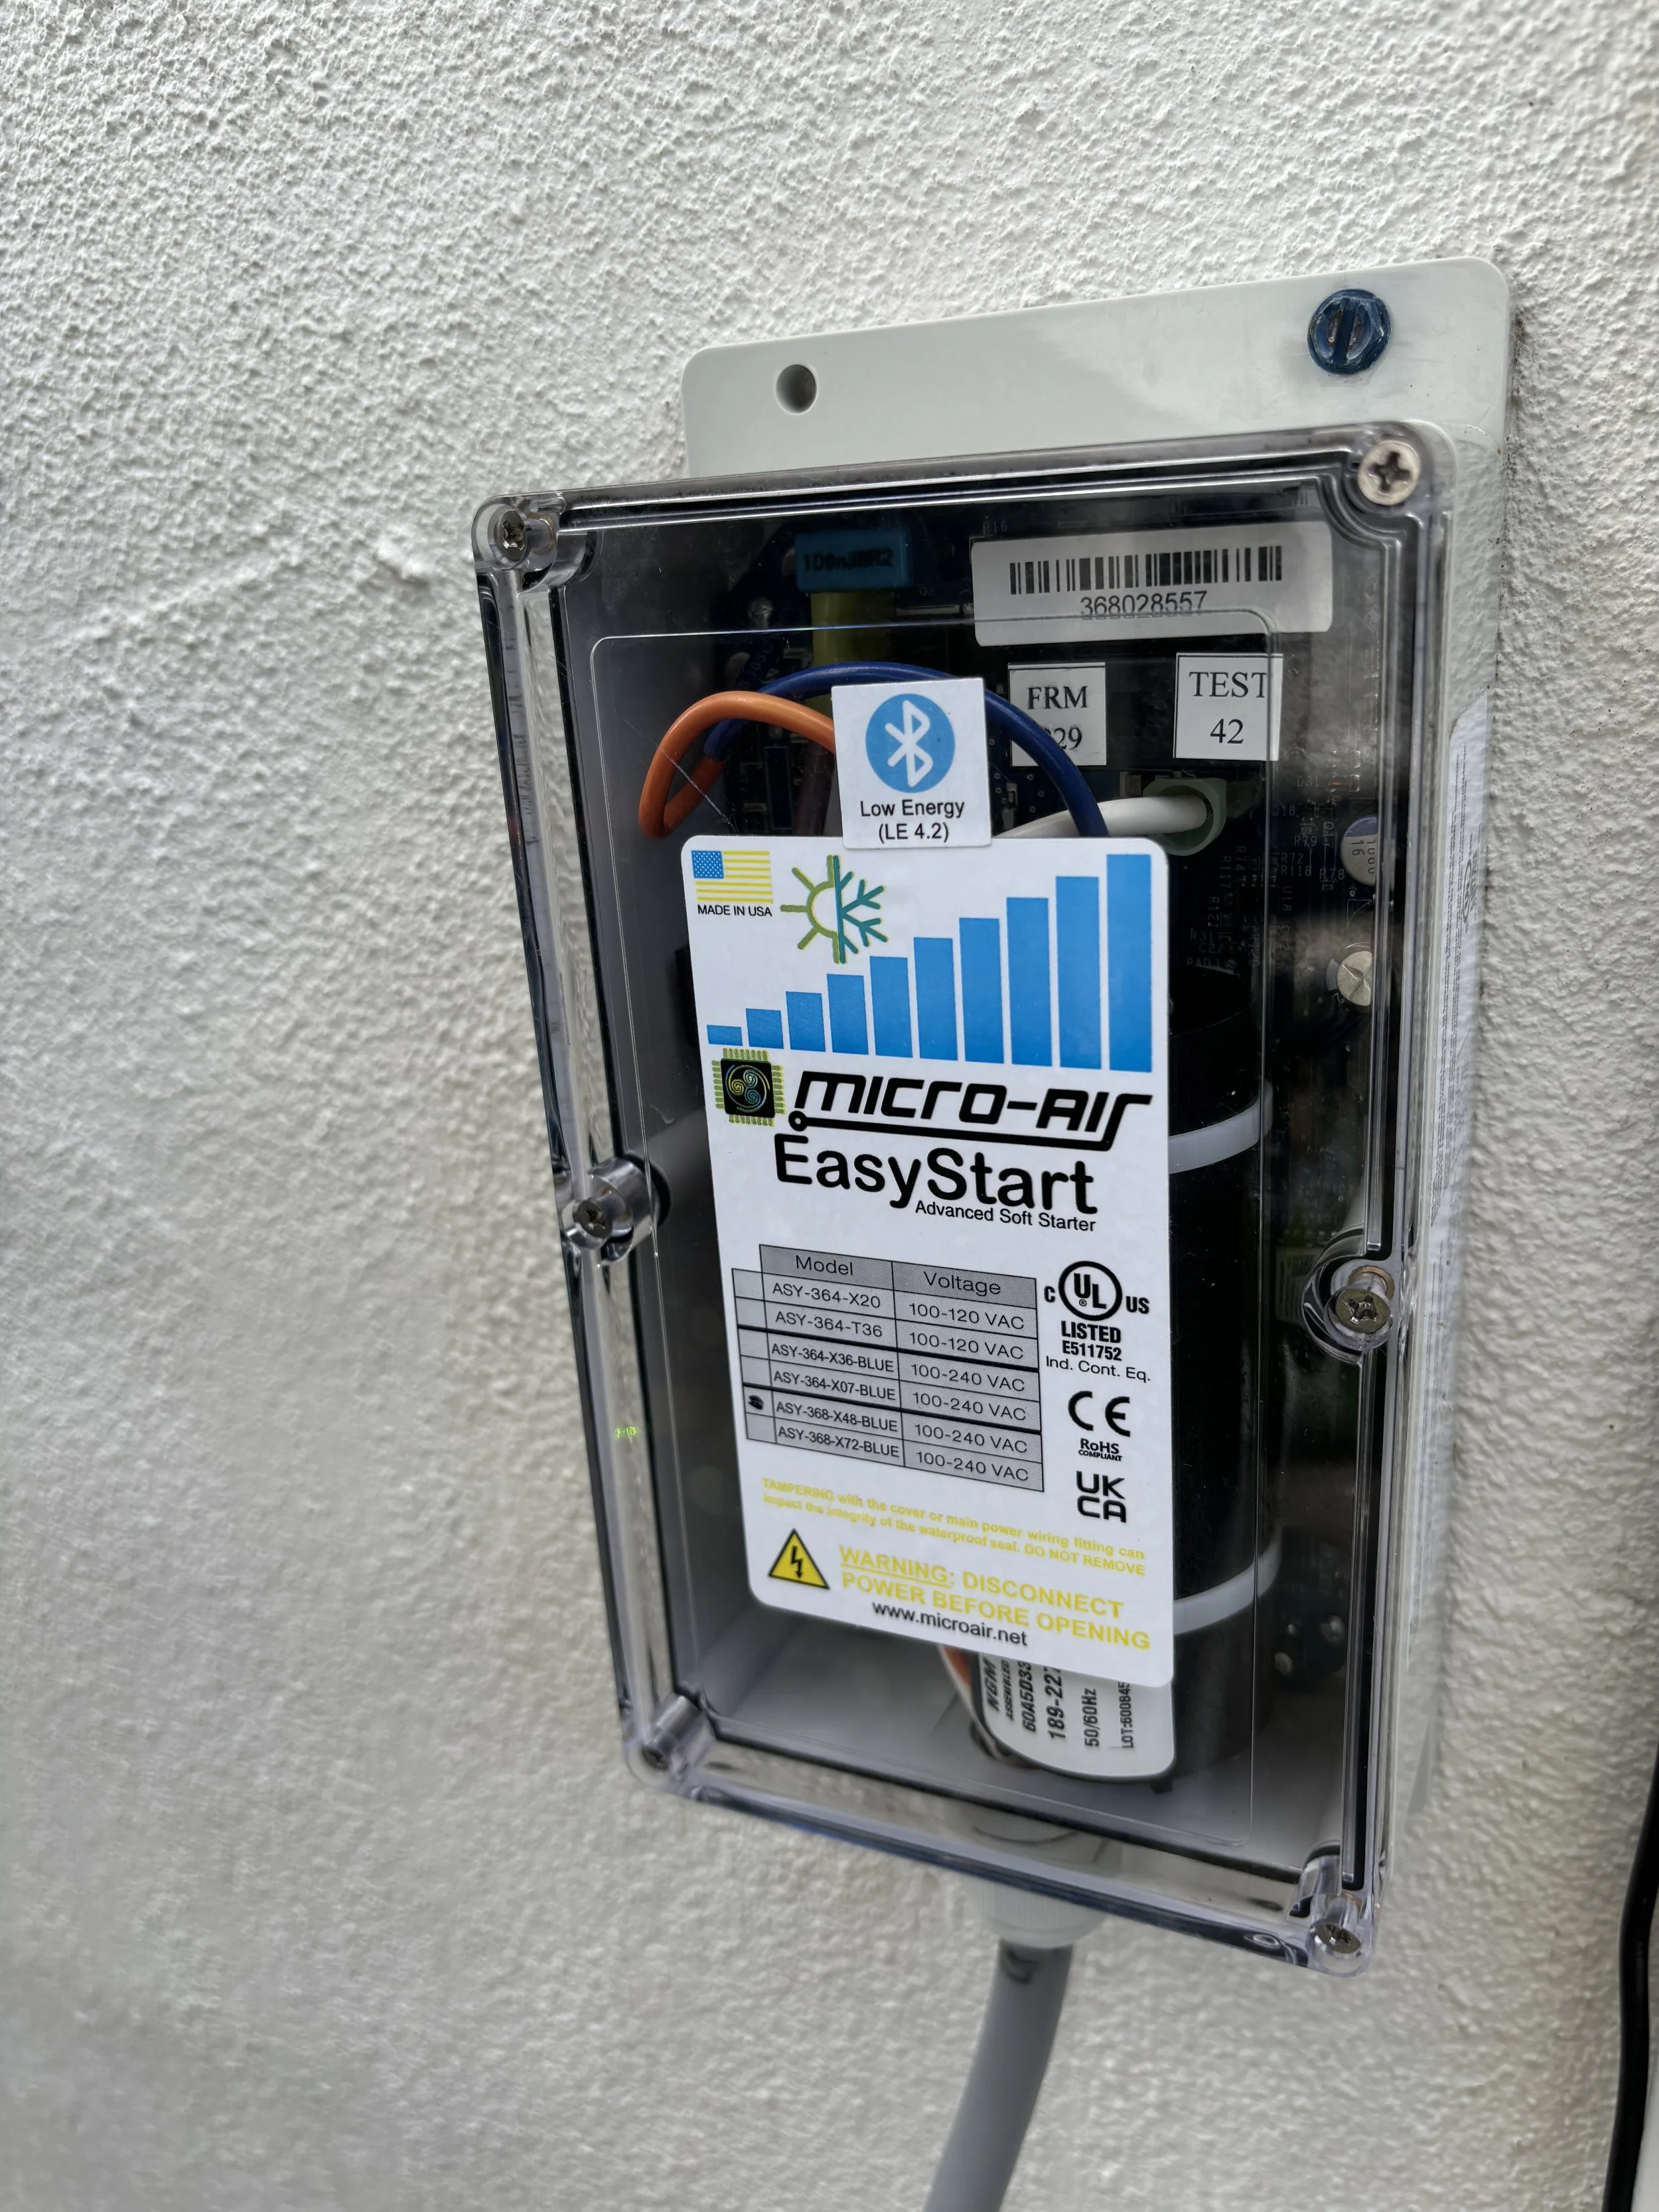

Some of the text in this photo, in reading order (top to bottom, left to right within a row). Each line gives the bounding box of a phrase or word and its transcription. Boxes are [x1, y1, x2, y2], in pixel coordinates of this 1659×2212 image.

[1080, 590, 1207, 620] 368028557
[1027, 686, 1088, 709] FRM
[1189, 671, 1267, 699] TEST
[1045, 726, 1082, 751] 29
[1210, 718, 1244, 745] 42
[860, 799, 965, 819] Low Energy
[879, 822, 949, 844] (LE 4.2)
[697, 904, 772, 917] MADE IN USA
[774, 1133, 1098, 1215] EasyStart
[915, 1200, 1096, 1232] Advanced Soft Starter
[796, 1255, 853, 1276] Model
[772, 1282, 881, 1308] ASY-364-X20
[924, 1271, 1001, 1297] Voltage
[1074, 1273, 1107, 1309] UL
[909, 1303, 1024, 1329] 100-120 VAC
[1125, 1295, 1149, 1314] US
[775, 1311, 883, 1337] ASY-364-T36
[1061, 1320, 1121, 1343] LISTED
[772, 1343, 895, 1372] ASY-364-X36-BLUE
[909, 1332, 1023, 1359] 100-120 VAC
[1062, 1339, 1122, 1361] E511752
[911, 1364, 1025, 1392] 100-240 VAC
[1046, 1355, 1151, 1383] Ind. Cont. Eq.
[774, 1370, 896, 1400] ASY-364-X07-BLUE
[776, 1401, 898, 1432] ASY-368-X48-BLUE
[913, 1392, 1026, 1421] 100-240 VAC
[1068, 1390, 1131, 1438] CE
[778, 1426, 899, 1457] ASY-368-X72-BLUE
[915, 1424, 1027, 1453] 100-240 VAC
[1080, 1438, 1119, 1454] RoHS
[916, 1451, 1029, 1481] 100-240 VAC
[1078, 1449, 1123, 1461] COMPLIANT
[1076, 1471, 1125, 1499] UK
[762, 1477, 1145, 1560] TAMPERING with the cover or main power wiring fitting can
[1077, 1495, 1126, 1523] CA
[805, 1501, 824, 1514] the
[827, 1505, 877, 1526] integrity
[880, 1517, 893, 1527] of
[895, 1518, 915, 1532] the
[918, 1524, 987, 1546] waterproof
[990, 1538, 1020, 1553] seal.
[1024, 1543, 1045, 1557] DO
[1049, 1548, 1078, 1564] NOT
[1082, 1554, 1146, 1576] REMOVE
[838, 1544, 1124, 1618] WARNING: DISCONNECT
[841, 1572, 1151, 1650] POWER BEFORE OPENING
[872, 1601, 1029, 1646] www.microair.net
[1081, 1687, 1100, 1747] 50/60Hz
